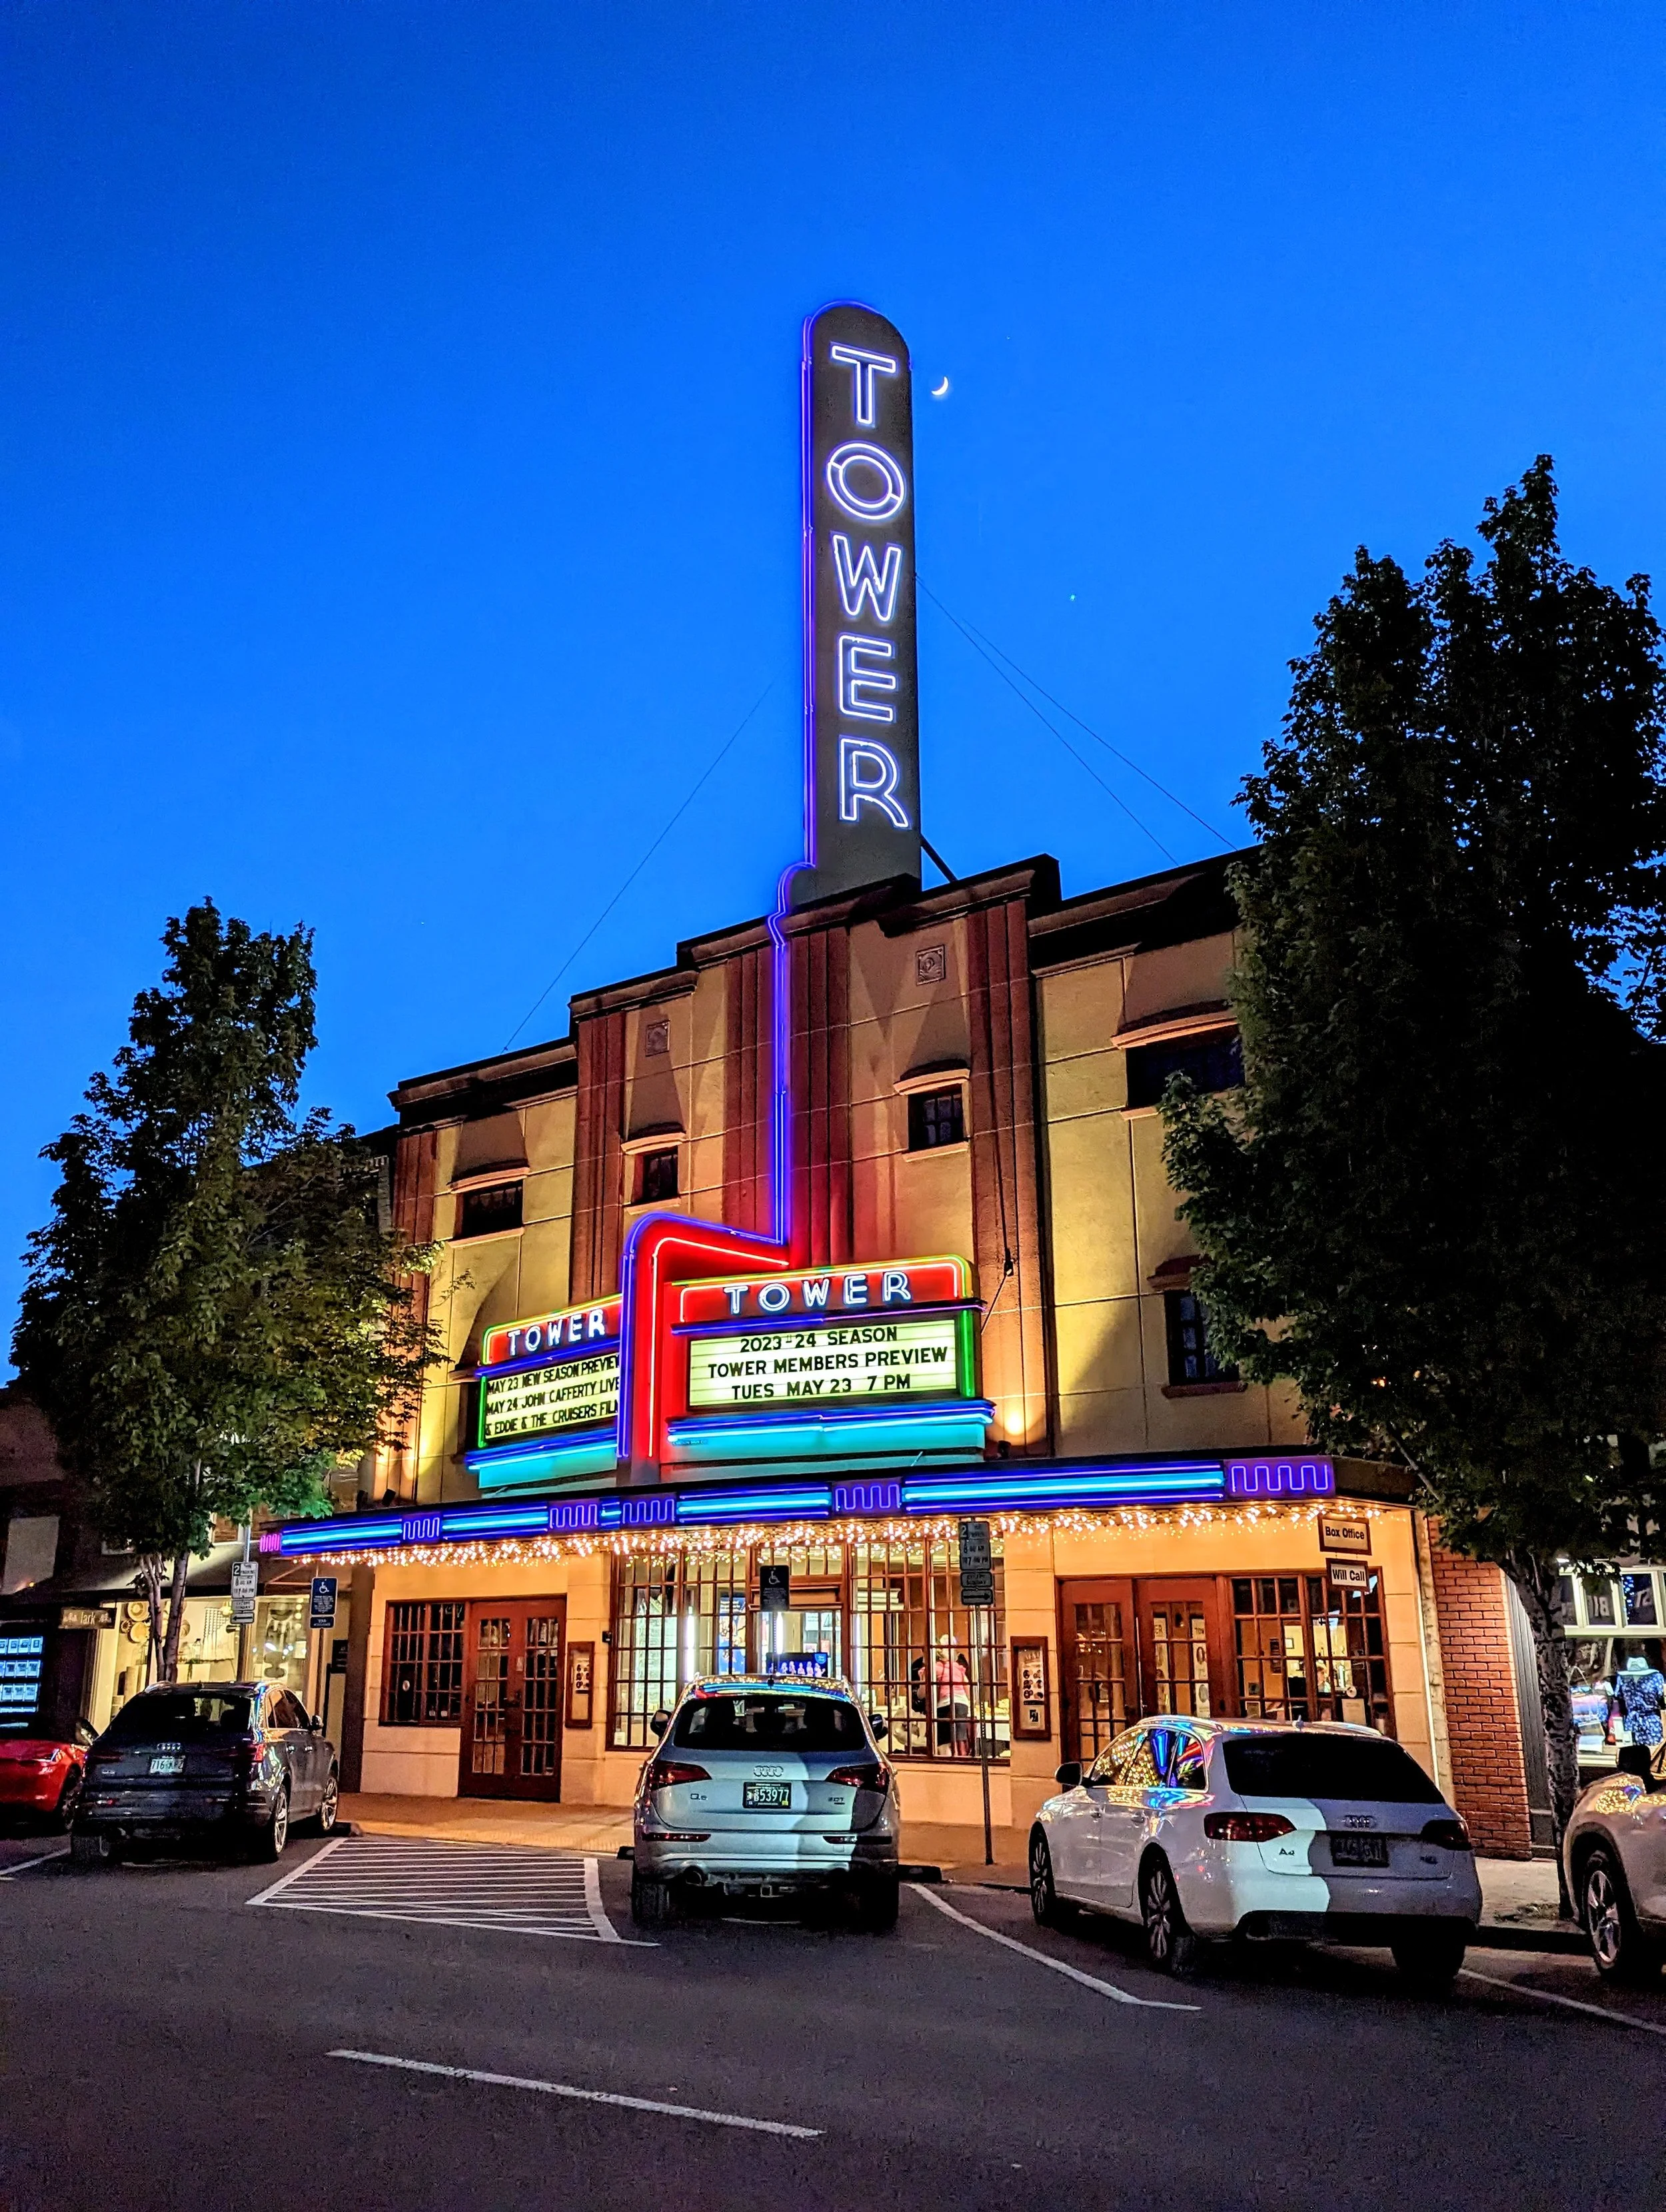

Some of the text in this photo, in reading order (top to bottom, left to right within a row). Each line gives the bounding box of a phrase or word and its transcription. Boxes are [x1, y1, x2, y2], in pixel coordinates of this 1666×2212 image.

[826, 344, 912, 830] TOWER
[723, 1271, 912, 1315] TOWER
[506, 1308, 606, 1357] TOWER
[740, 1327, 898, 1353] 2023-24 SEASON
[707, 1347, 948, 1379] TOWER MEMBERS PREVIEW
[488, 1378, 506, 1394] MAY
[507, 1375, 519, 1390] 23
[522, 1371, 541, 1387] NEW
[543, 1361, 580, 1383] SEASON
[731, 1373, 911, 1400] TUES MAY 23 7 PM
[486, 1375, 620, 1415] MAY 24 JOHN CAFFERTY LIVE
[494, 1417, 518, 1434] EDDIE
[531, 1412, 548, 1427] THE
[552, 1403, 598, 1424] CRUISERS
[960, 1525, 968, 1538] 2
[1325, 1526, 1365, 1540] Box Office
[233, 1564, 240, 1575] 2
[1332, 1569, 1365, 1581] Will Call
[80, 1611, 96, 1625] lark
[151, 1760, 165, 1770] 716
